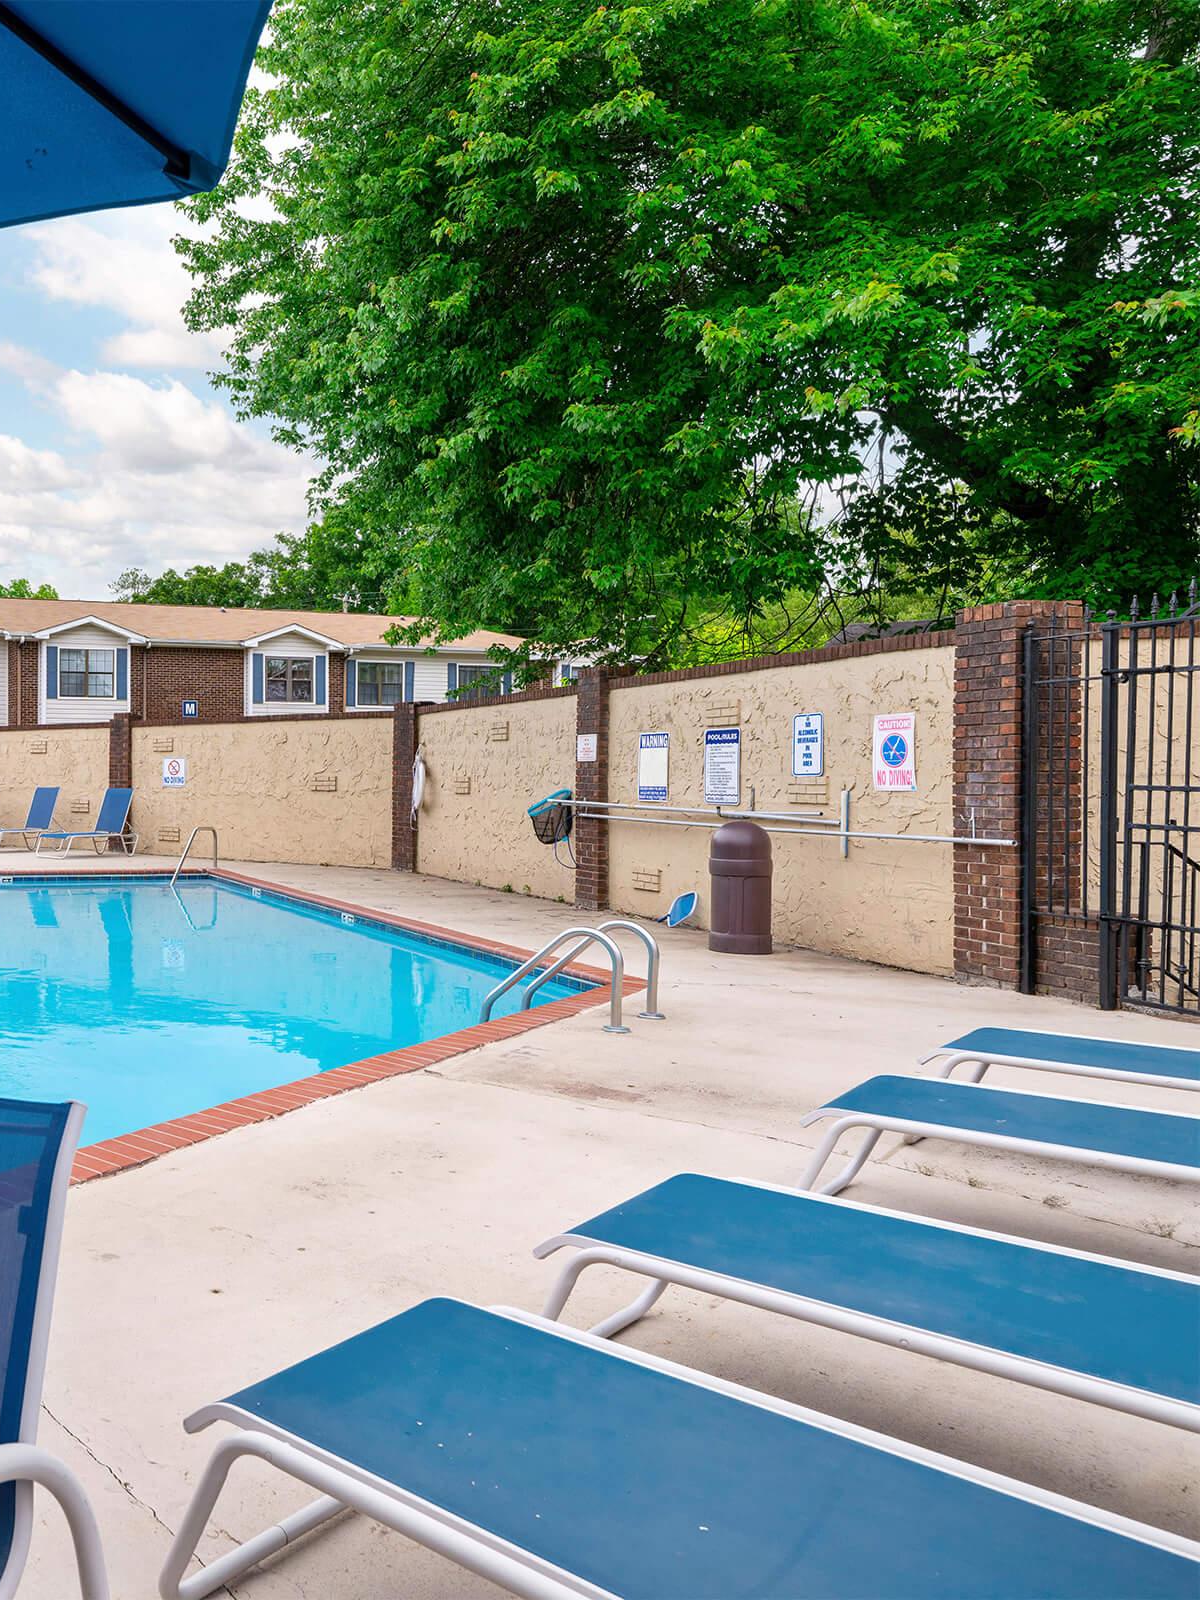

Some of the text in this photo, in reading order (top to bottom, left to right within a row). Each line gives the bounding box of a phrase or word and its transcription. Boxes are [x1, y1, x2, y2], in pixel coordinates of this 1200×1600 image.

[185, 703, 195, 715] M
[640, 734, 669, 747] WARNING
[877, 769, 887, 785] NO
